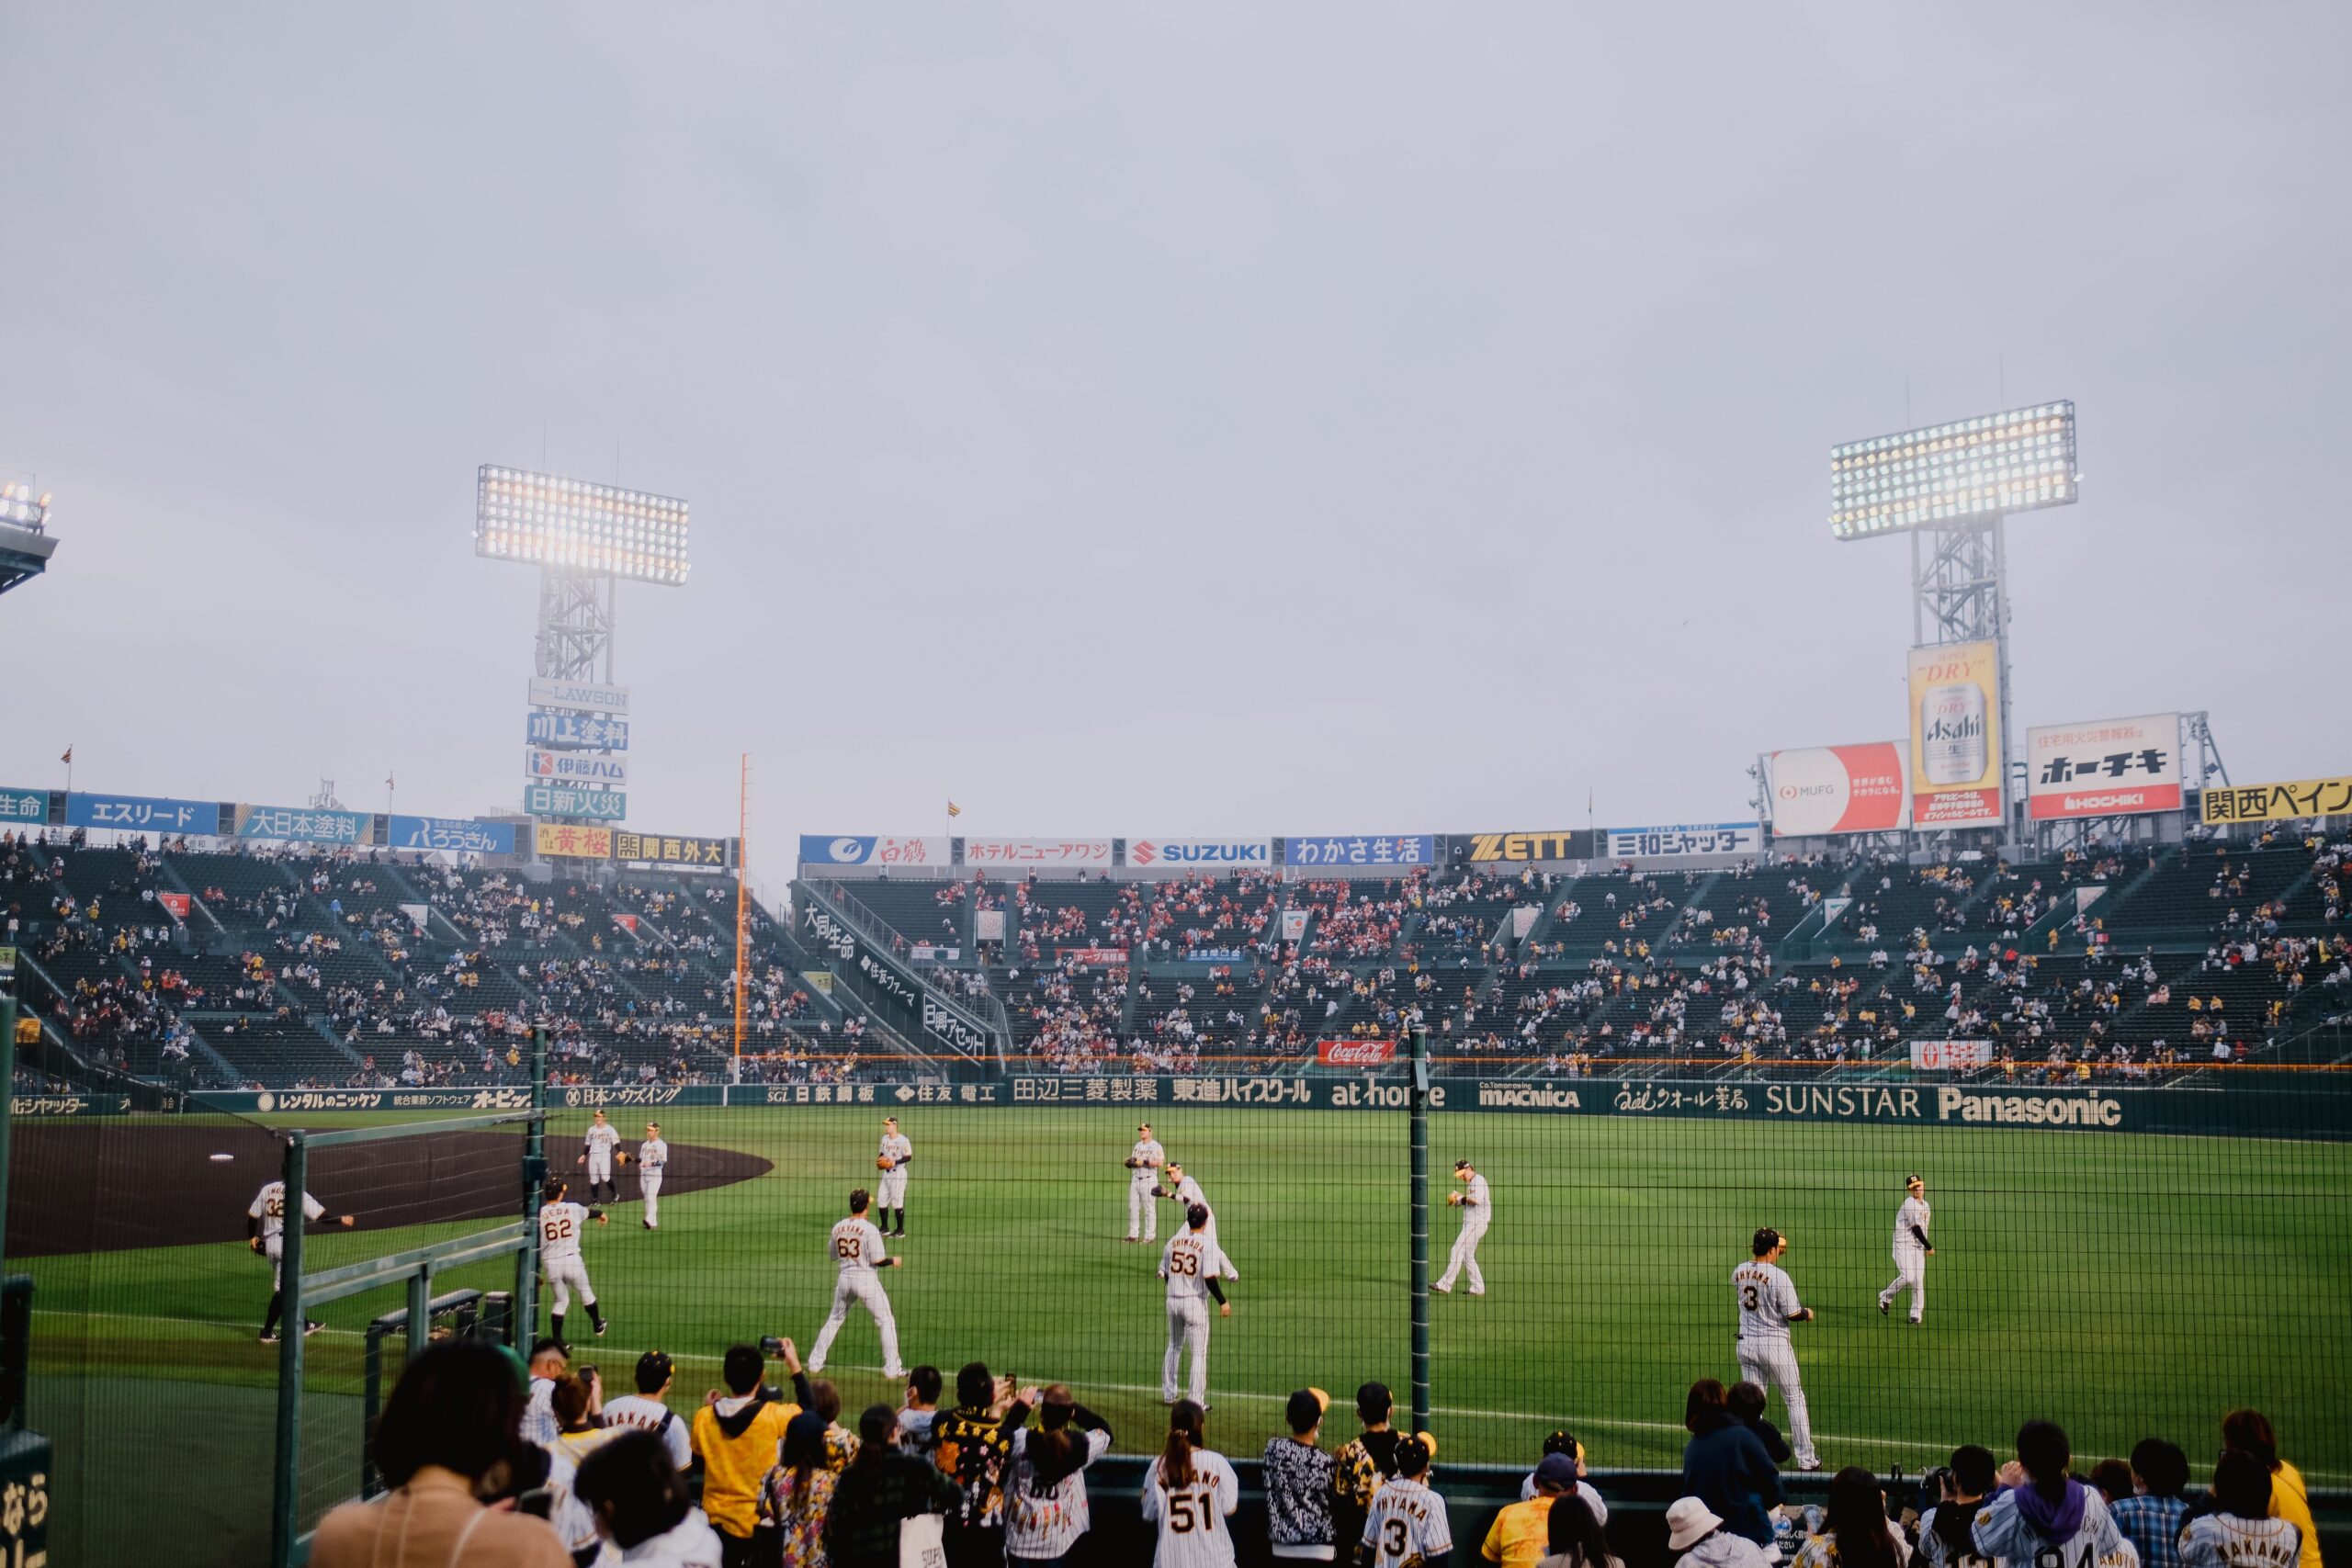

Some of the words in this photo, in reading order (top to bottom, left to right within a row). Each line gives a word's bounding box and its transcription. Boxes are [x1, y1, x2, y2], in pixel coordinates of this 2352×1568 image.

[553, 686, 628, 706] LAWSON
[532, 715, 627, 748] 川上塗料
[1928, 714, 1980, 742] Asahi
[2037, 727, 2144, 749] 住宅用火災警報器は
[557, 757, 624, 778] 伊藤ハム
[2040, 749, 2166, 784] ホーチキ
[533, 788, 620, 817] 日新火災
[1800, 784, 1834, 797] MUFG
[2075, 793, 2144, 809] HOCHIKI
[92, 802, 197, 828] エスリード
[252, 810, 357, 841] 大日本塗料
[433, 829, 498, 852] ろうきん
[555, 827, 609, 856] 黄桜
[642, 837, 722, 863] 関西外大
[880, 838, 926, 863] 白鶴
[968, 843, 1110, 861] ホテルニューアワジ
[1163, 844, 1266, 862] SUZUKI
[1297, 837, 1420, 863] わかさ生活
[1470, 831, 1571, 863] ZETT
[805, 902, 855, 961] 大同生命
[870, 962, 915, 1008] 住友ファーマ
[925, 1004, 984, 1055] 日興アセット
[279, 1093, 382, 1109] レンタルのニッケン
[393, 1094, 471, 1106] 統合業務ソフトウェア
[583, 1087, 683, 1106] 日本ハウズイング
[797, 1085, 875, 1102] 日鉄鋼板
[1013, 1077, 1158, 1102] 田辺三菱製薬
[1172, 1077, 1312, 1103] 東進ハイスクール
[1657, 1085, 1749, 1111] クオール薬局
[1766, 1086, 1922, 1118] SUNSTAR
[1938, 1087, 2121, 1126] Panasonic
[542, 1208, 571, 1220] UEDA
[545, 1219, 572, 1241] 62
[837, 1237, 860, 1258] 63
[1171, 1238, 1204, 1253] SHIMADA
[1170, 1250, 1197, 1276] 53
[1743, 1285, 1758, 1312] 3
[1168, 1492, 1214, 1534] 51
[1384, 1517, 1408, 1557] 3
[2215, 1538, 2291, 1565] NAKANO
